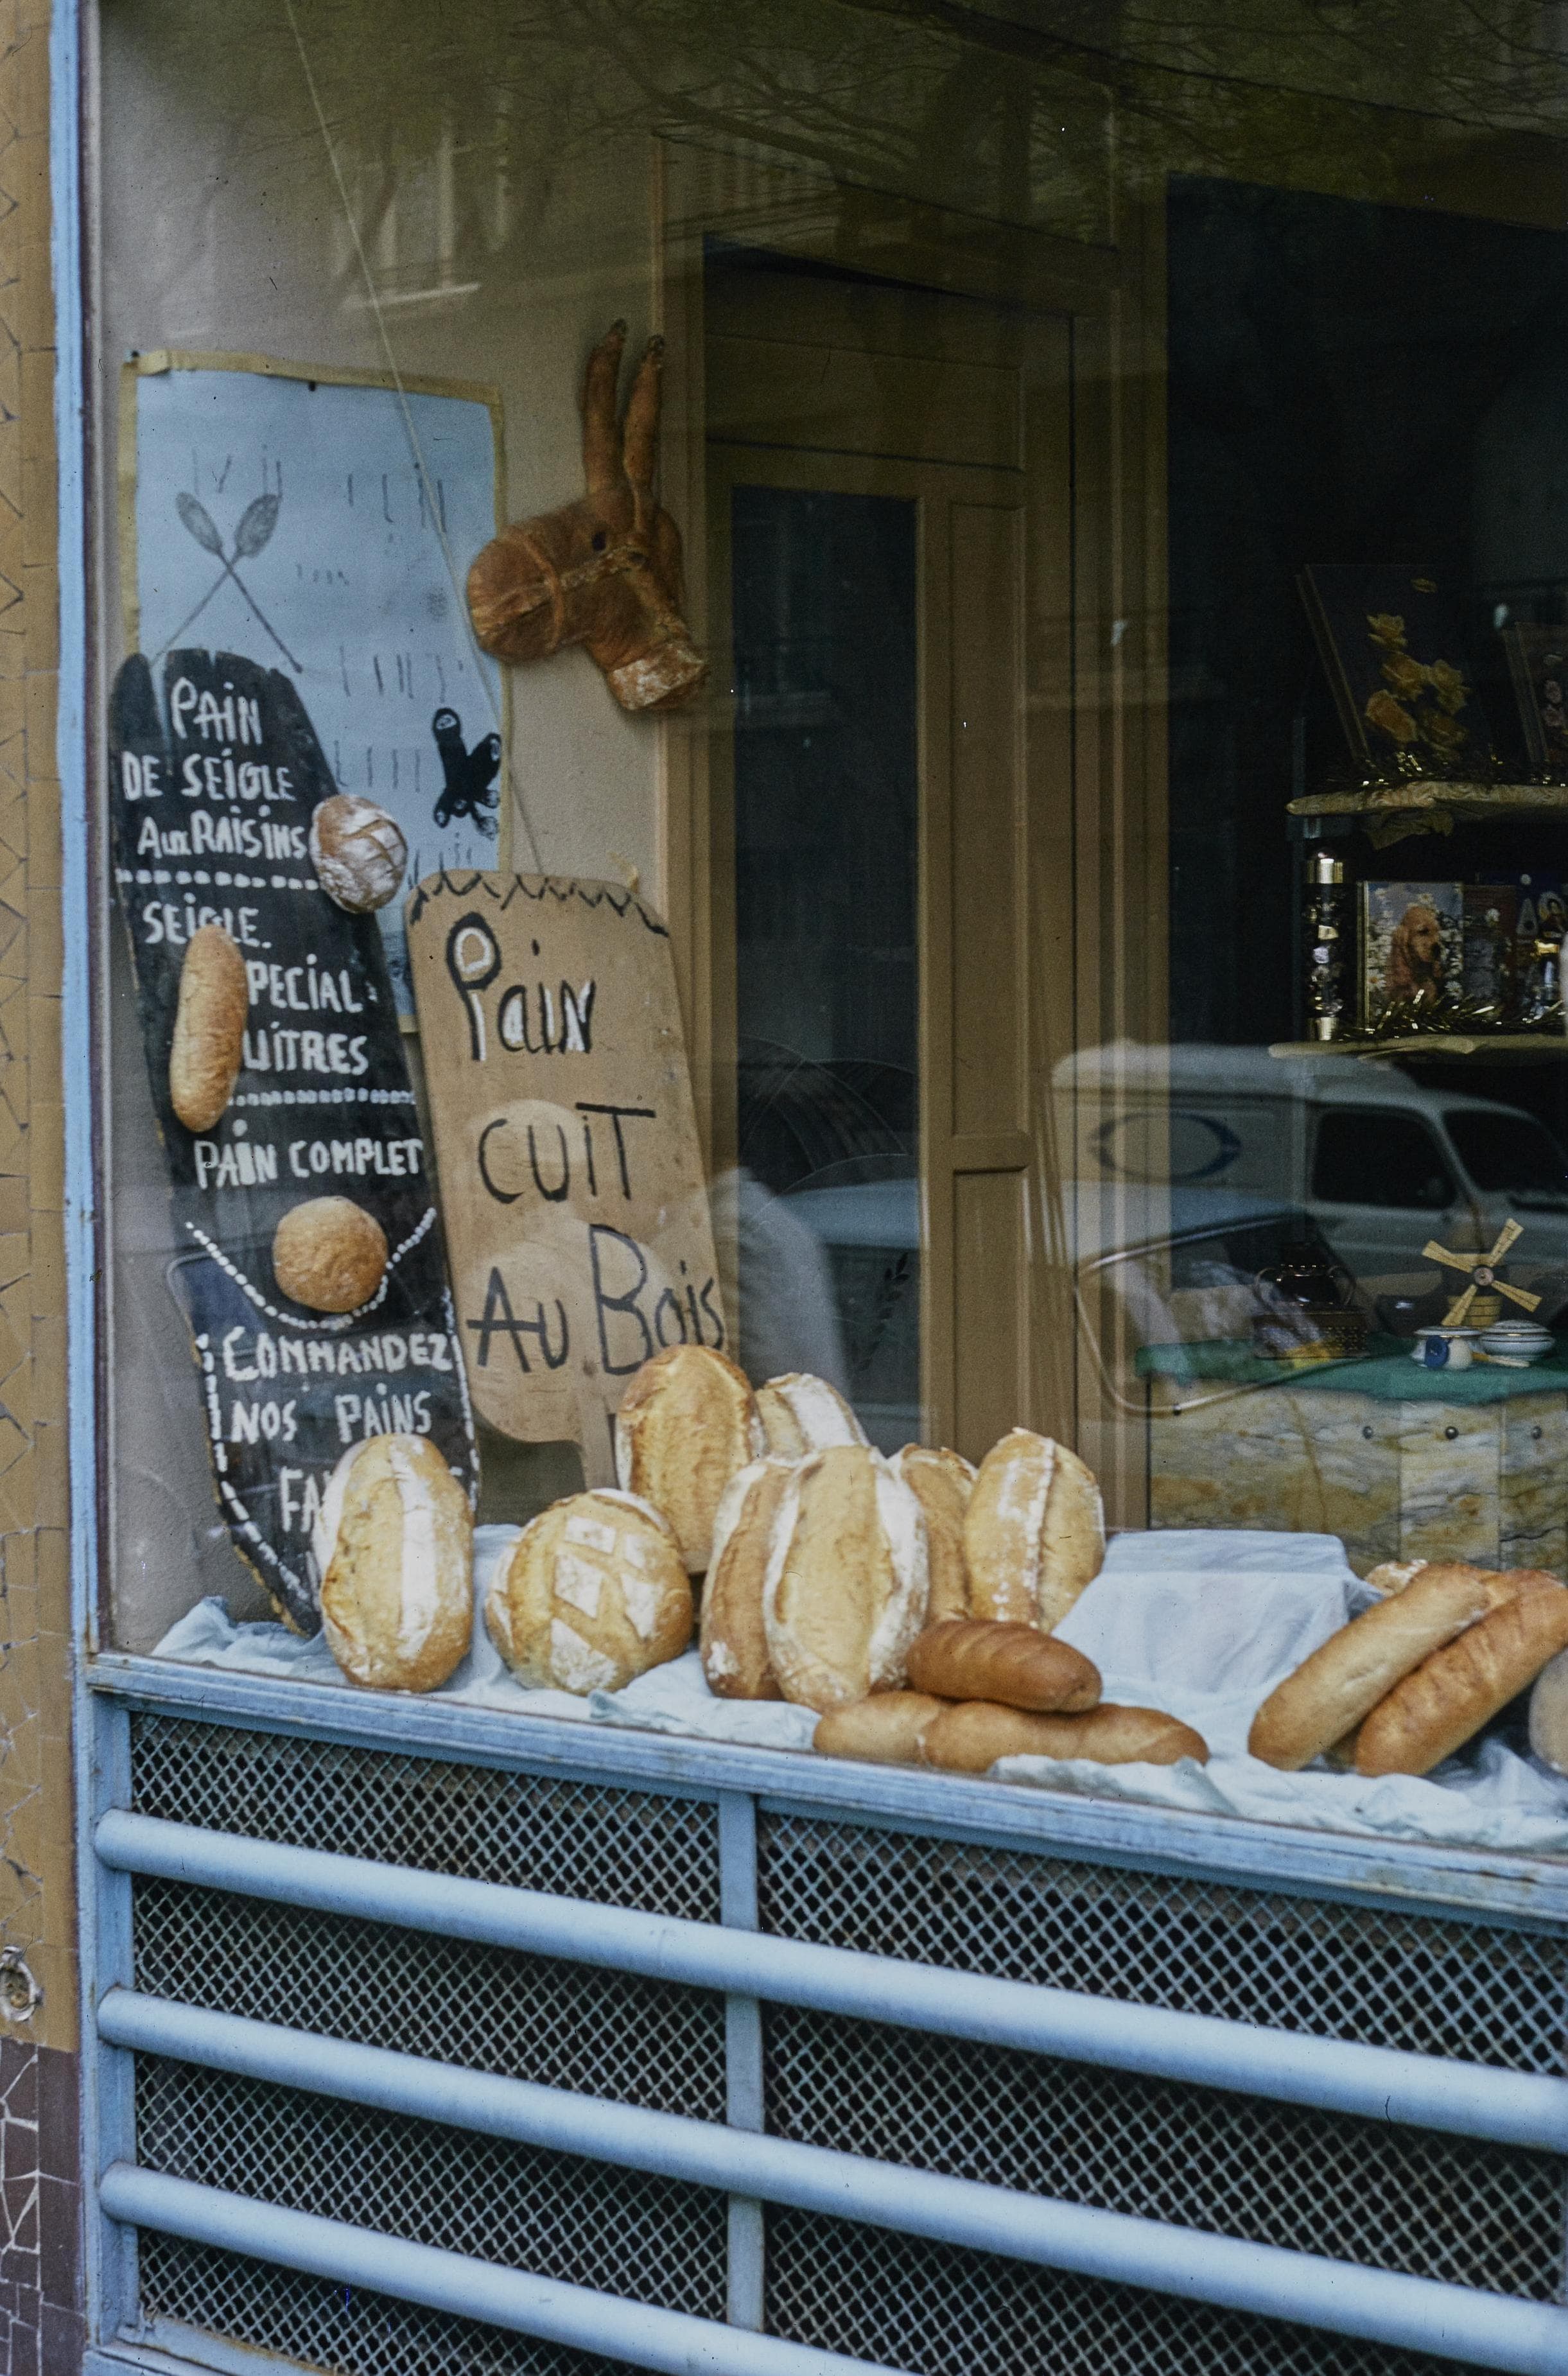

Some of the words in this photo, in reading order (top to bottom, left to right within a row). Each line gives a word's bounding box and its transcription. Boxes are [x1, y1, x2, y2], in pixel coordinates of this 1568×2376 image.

[171, 677, 262, 744] PAIN
[121, 751, 162, 800] DE
[182, 747, 296, 801] SEIGLE
[190, 805, 308, 859] RAISINS
[246, 954, 363, 1013] PECIAL
[242, 1021, 369, 1075] UITRES
[195, 1119, 277, 1189] PAIN
[288, 1138, 423, 1178] COMPLET
[478, 1102, 656, 1203] CUIT
[222, 1326, 453, 1381] COMMANDEZ
[230, 1400, 297, 1444] NOS
[335, 1383, 431, 1443] PAINS
